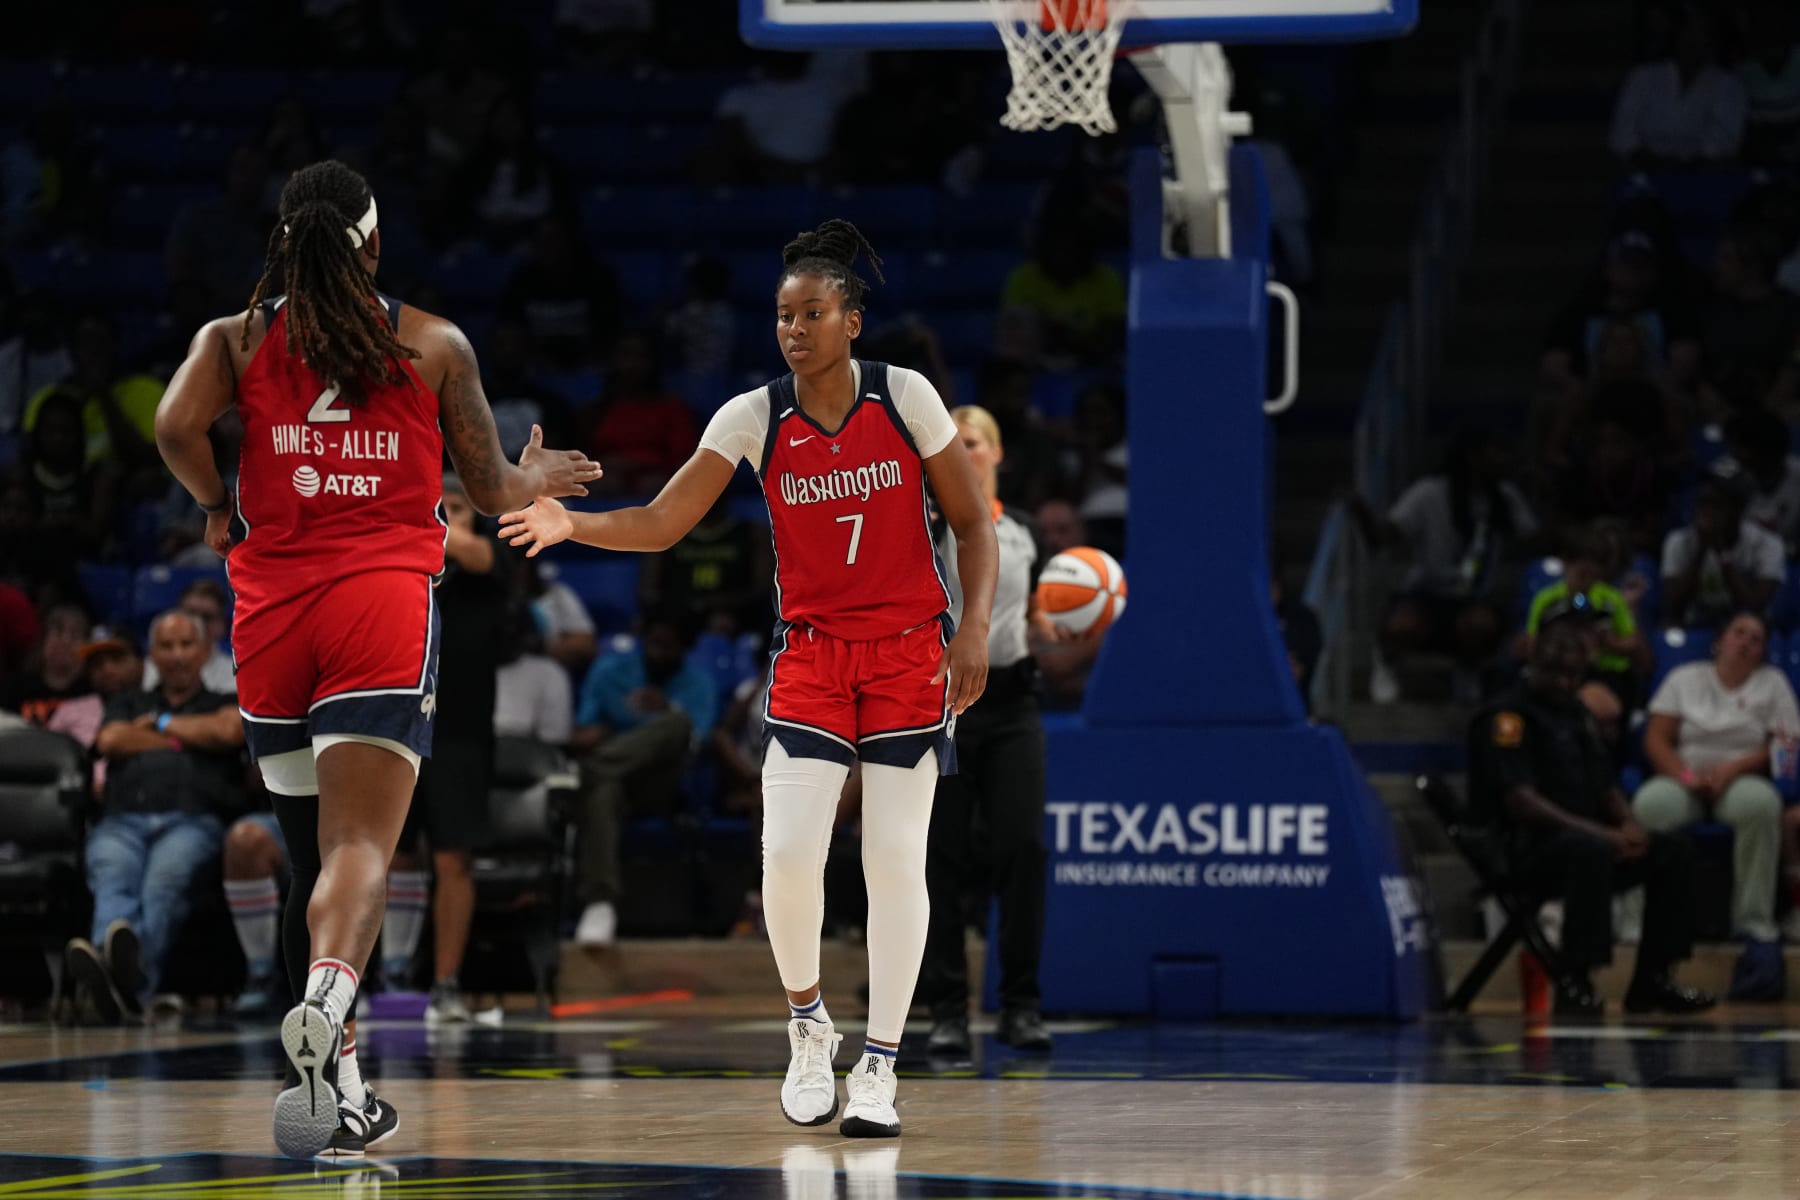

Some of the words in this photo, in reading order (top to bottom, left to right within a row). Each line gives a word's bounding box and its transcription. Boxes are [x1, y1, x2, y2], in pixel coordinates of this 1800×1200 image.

[271, 424, 399, 461] HINES-ALLEN
[323, 474, 381, 496] AT&T
[780, 459, 903, 506] Washington
[835, 513, 864, 565] 7
[1055, 863, 1197, 886] INSURANCE
[1204, 864, 1330, 887] COMPANY
